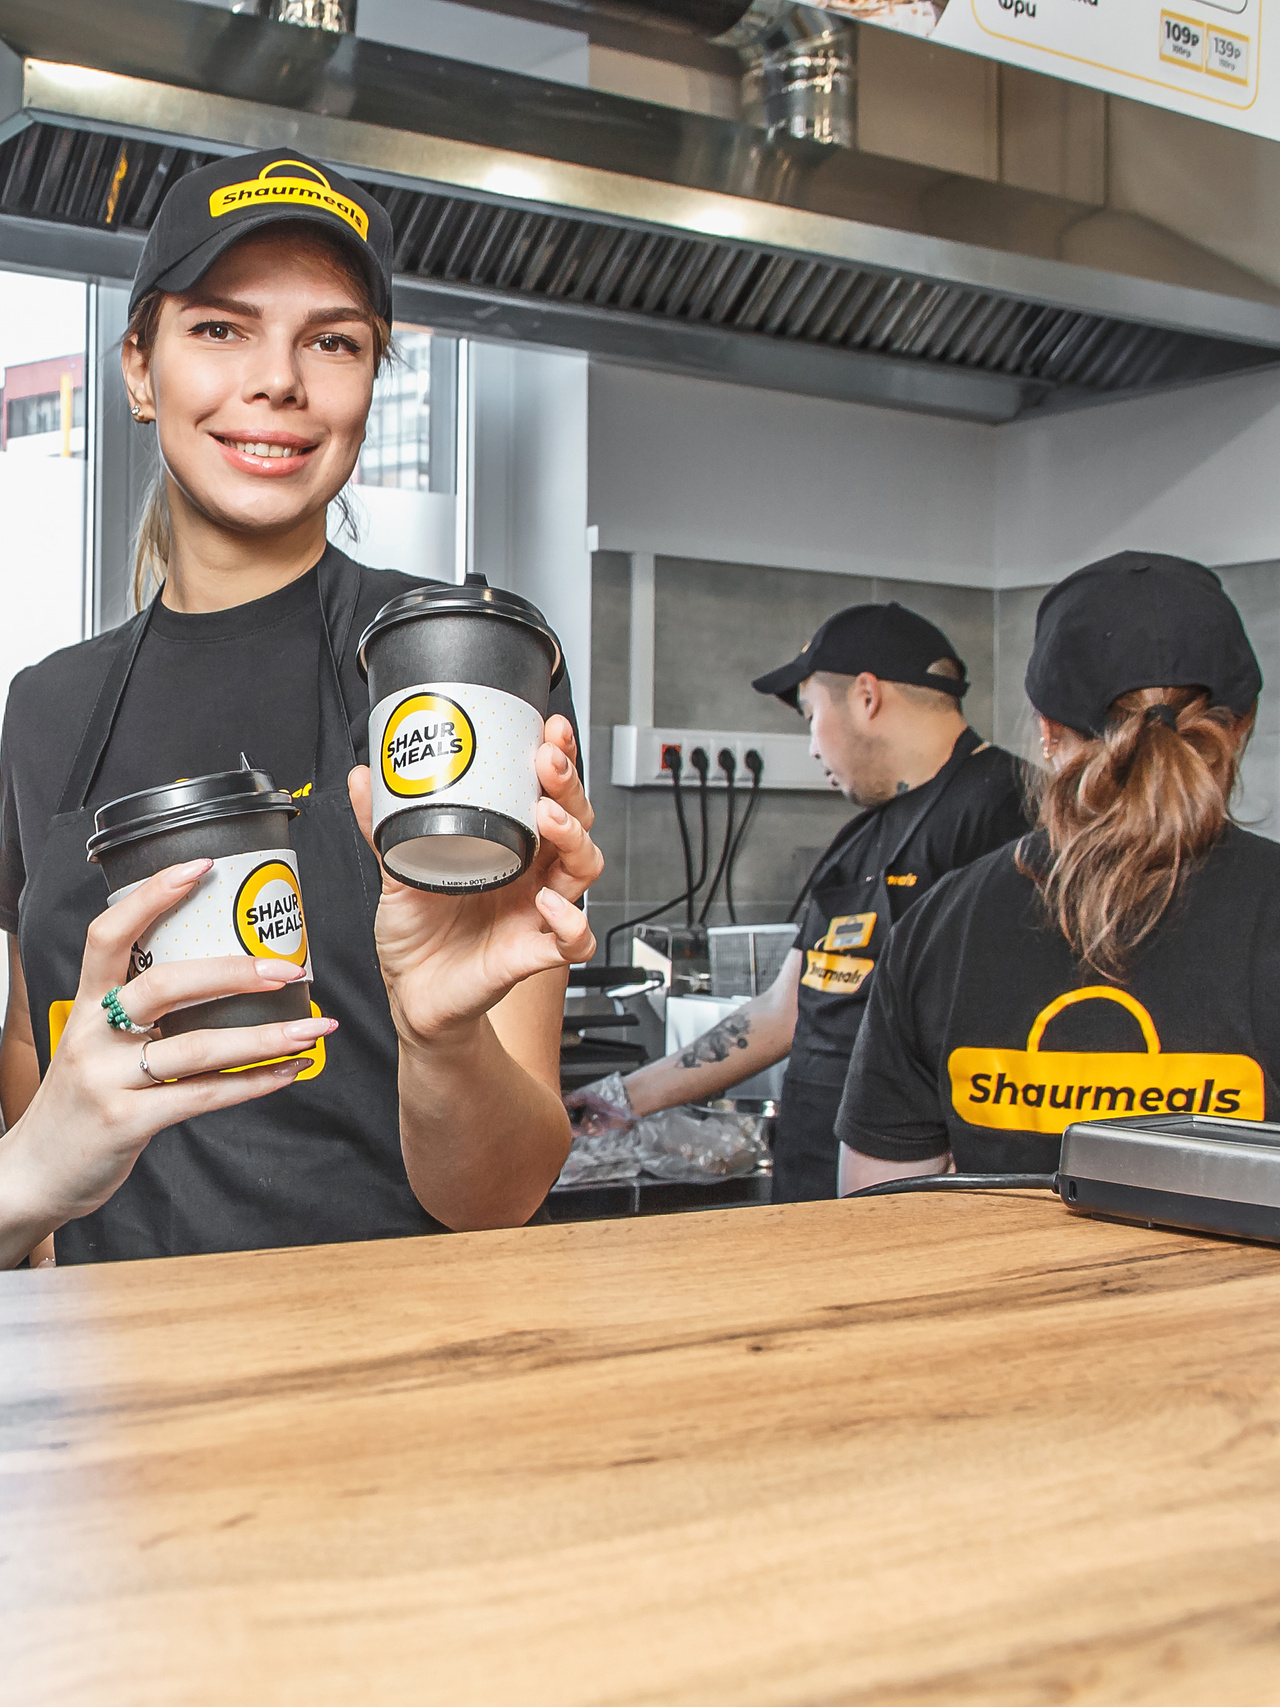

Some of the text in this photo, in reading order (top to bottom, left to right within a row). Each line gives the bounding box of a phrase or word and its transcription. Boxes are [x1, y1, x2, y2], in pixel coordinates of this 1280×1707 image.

[222, 186, 363, 228] Shaurmeals
[387, 721, 455, 759] SHAUR
[393, 738, 463, 773] MEALS
[246, 893, 299, 926] SHAUR
[258, 910, 303, 943] MEALS
[968, 1072, 1241, 1114] Shaurmeals
